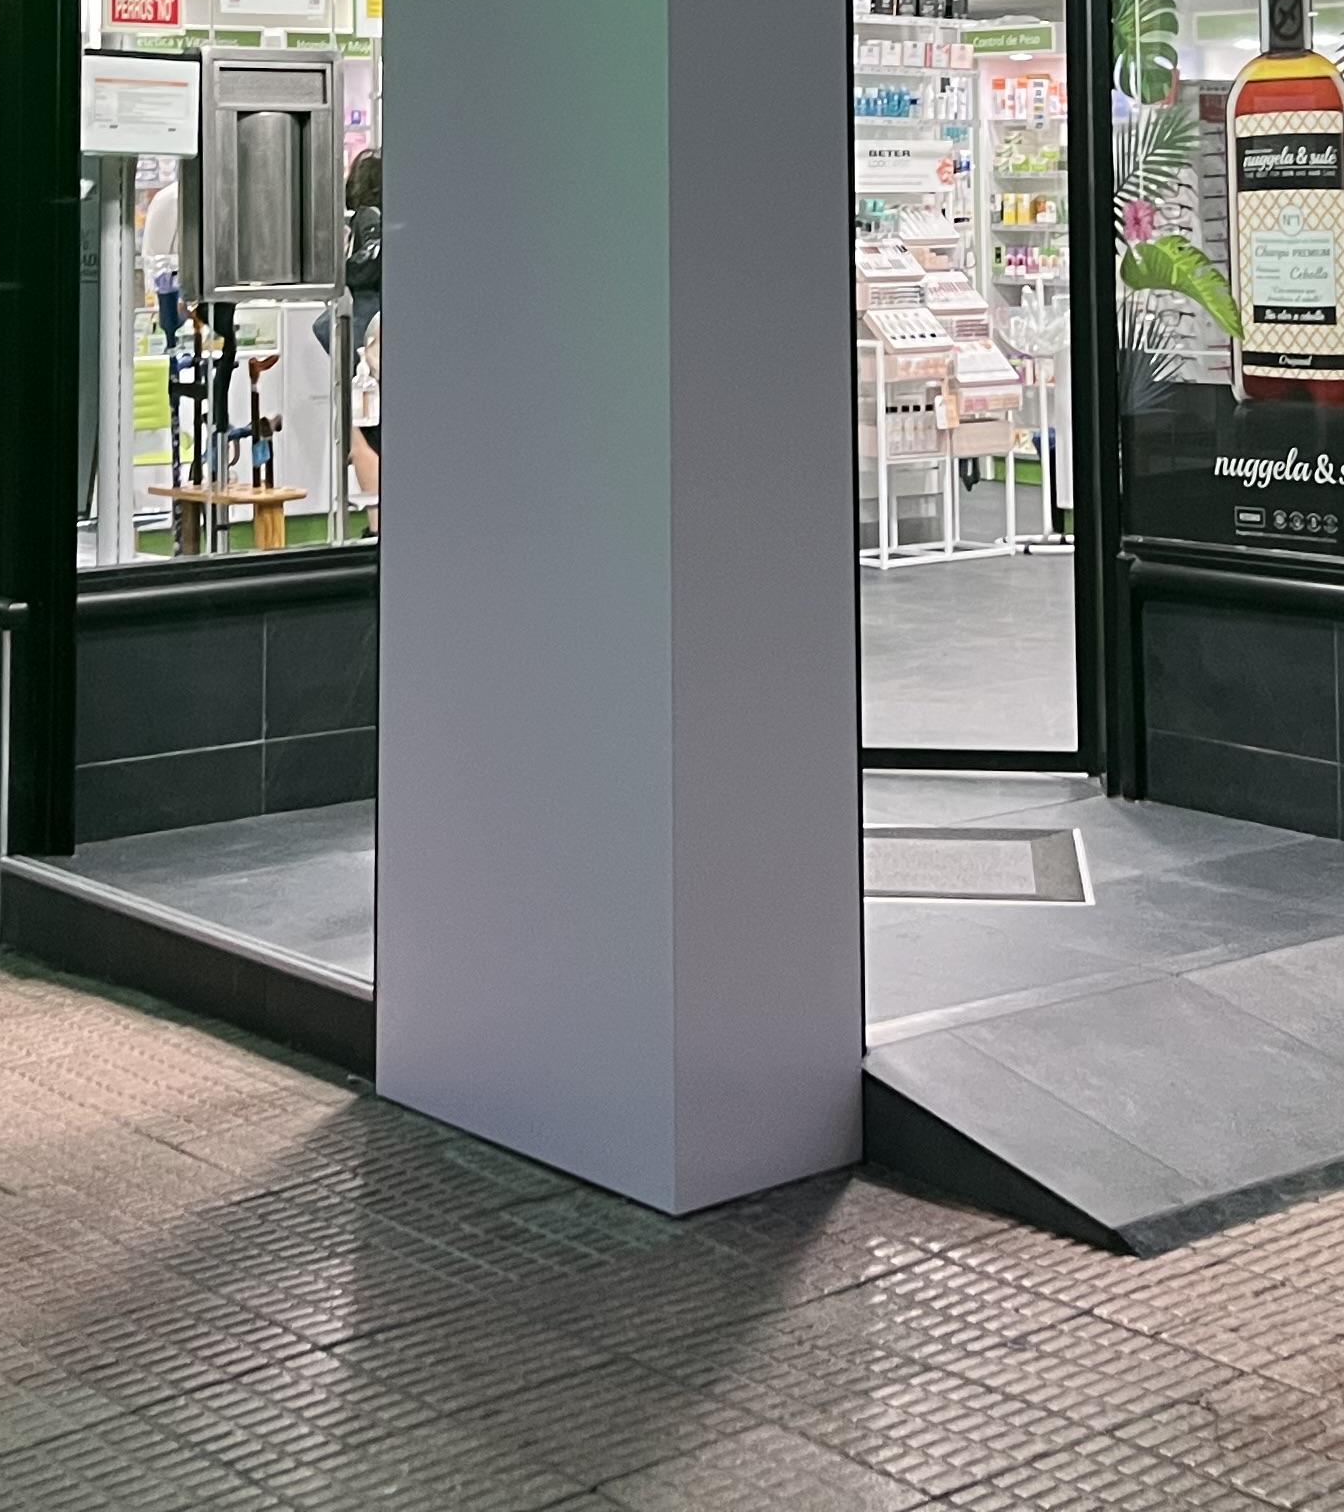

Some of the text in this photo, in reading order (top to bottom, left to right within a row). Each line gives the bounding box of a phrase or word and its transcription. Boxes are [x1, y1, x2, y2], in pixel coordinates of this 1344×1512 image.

[972, 33, 1041, 48] Control de Peso
[868, 149, 911, 158] BETER
[1242, 145, 1295, 172] nuggela
[1295, 146, 1308, 165] &
[1213, 446, 1313, 489] nuggela
[1313, 453, 1338, 485] &
